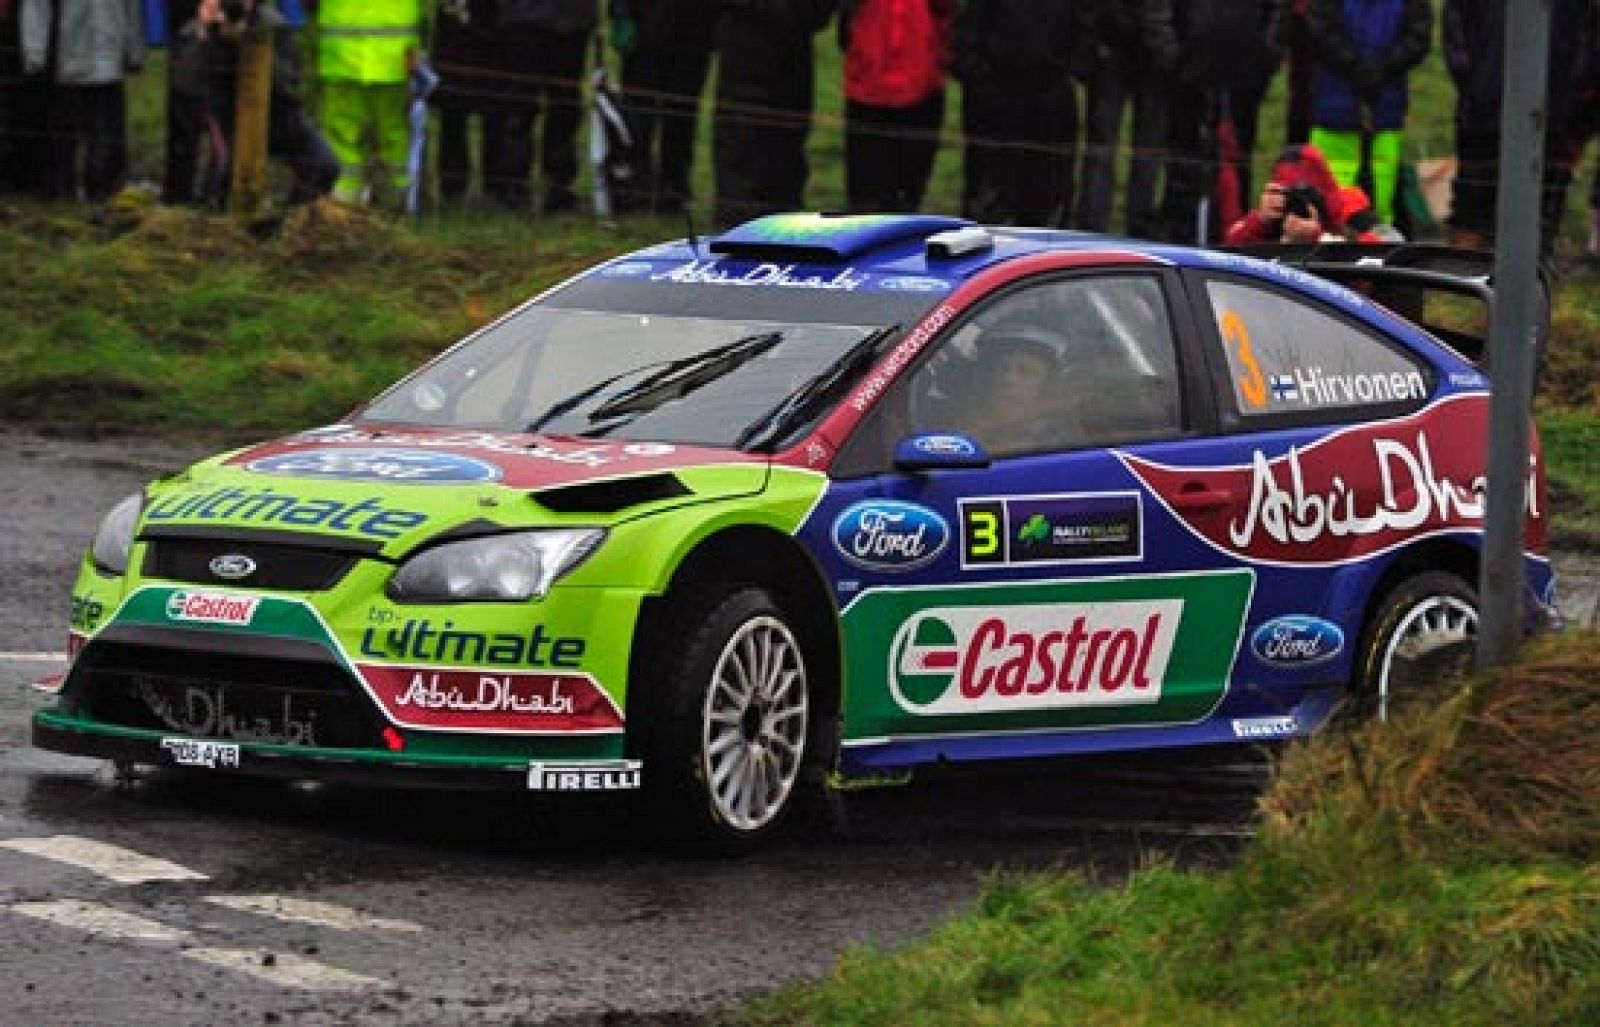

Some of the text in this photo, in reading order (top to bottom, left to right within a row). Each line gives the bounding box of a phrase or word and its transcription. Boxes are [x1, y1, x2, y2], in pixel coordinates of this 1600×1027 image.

[1222, 310, 1267, 408] 3
[1296, 366, 1427, 405] Hirvonen
[854, 510, 926, 557] Ford
[970, 511, 998, 556] 3
[185, 594, 250, 620] Castrol
[959, 613, 1161, 699] Castrol
[1265, 622, 1322, 657] Ford
[527, 759, 643, 790] PIRELLI
